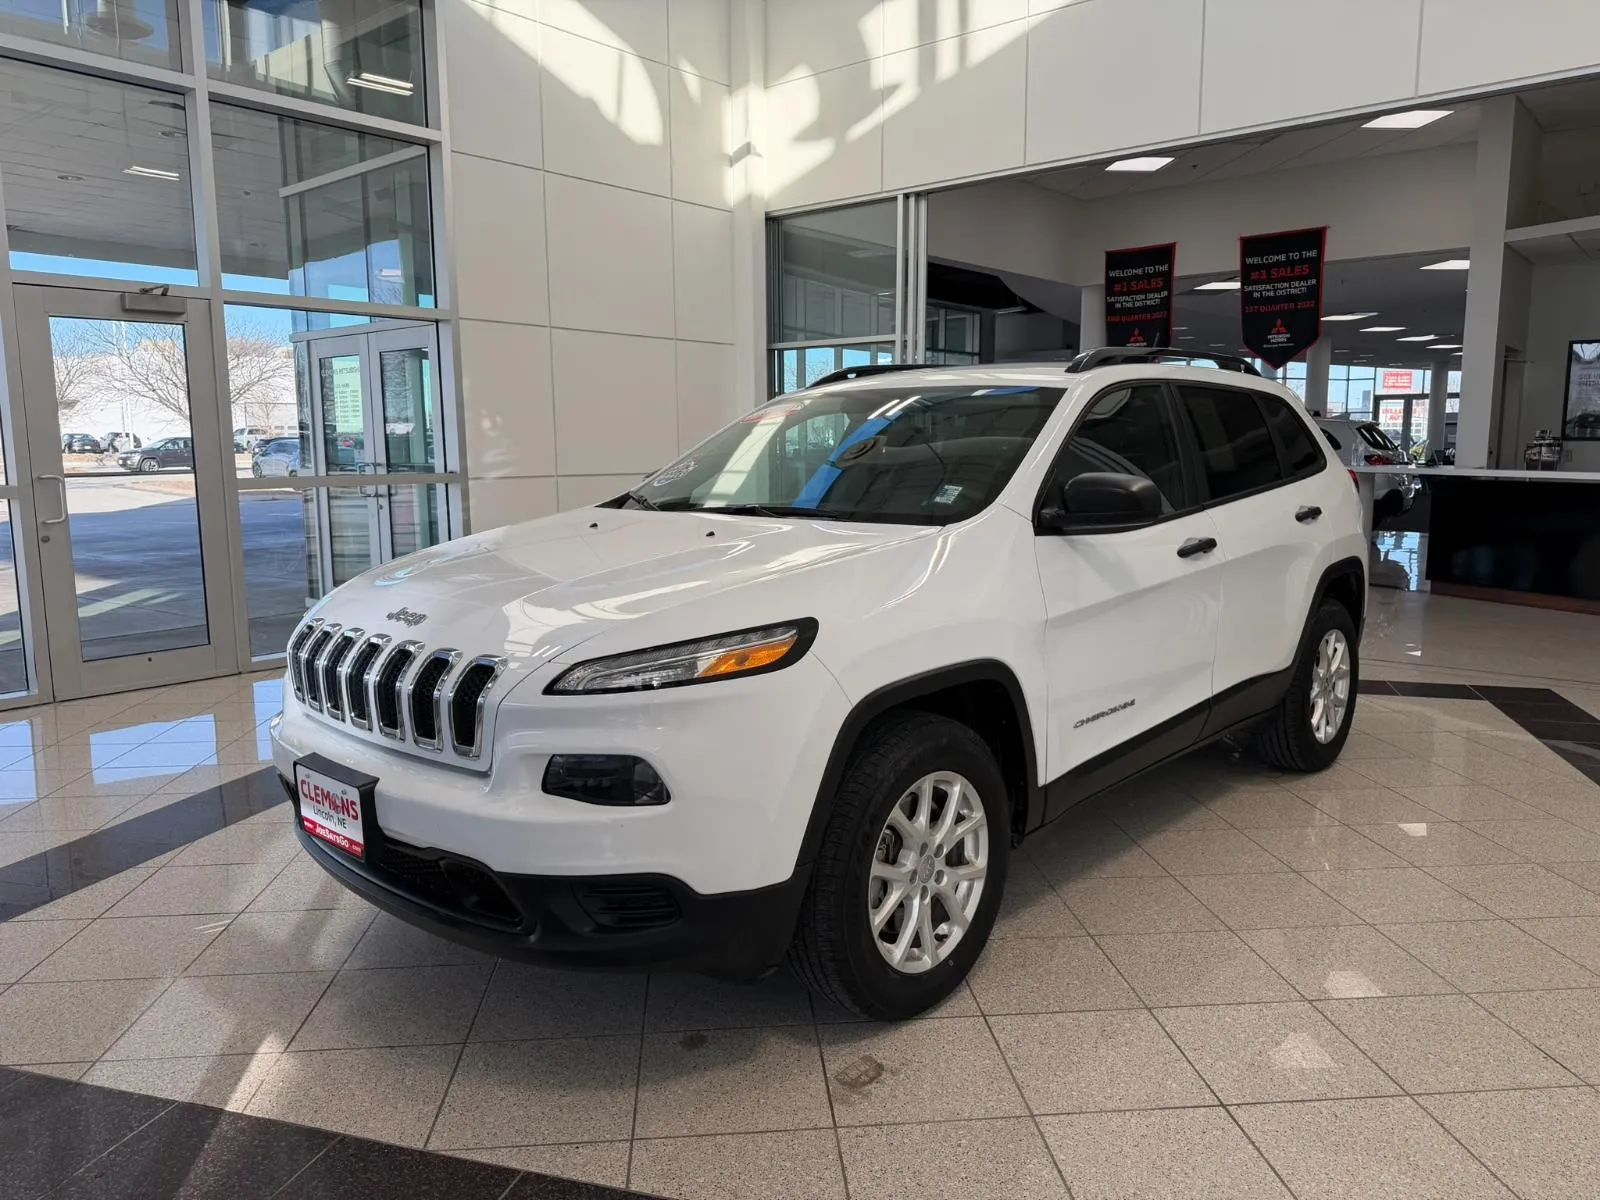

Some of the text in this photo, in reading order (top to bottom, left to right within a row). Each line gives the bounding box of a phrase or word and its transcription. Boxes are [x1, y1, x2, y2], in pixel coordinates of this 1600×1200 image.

[1245, 255, 1287, 264] WELCOME
[1302, 250, 1318, 258] THE
[1108, 264, 1169, 278] WELCOME TO THE
[1250, 265, 1310, 280] #1 SALES
[1114, 278, 1164, 291] #1 SALES
[1243, 279, 1317, 292] SATISFACTION DEALER
[1106, 291, 1169, 303] SATISFACTION DEALER
[1276, 288, 1307, 296] DISTRICT!
[1259, 304, 1295, 312] QUARTER
[1297, 301, 1316, 309] 2022
[386, 606, 428, 628] Jeep
[1073, 698, 1136, 729] CHEROKEE
[300, 779, 359, 820] CLEMONS
[313, 805, 347, 829] Lincoln, NE
